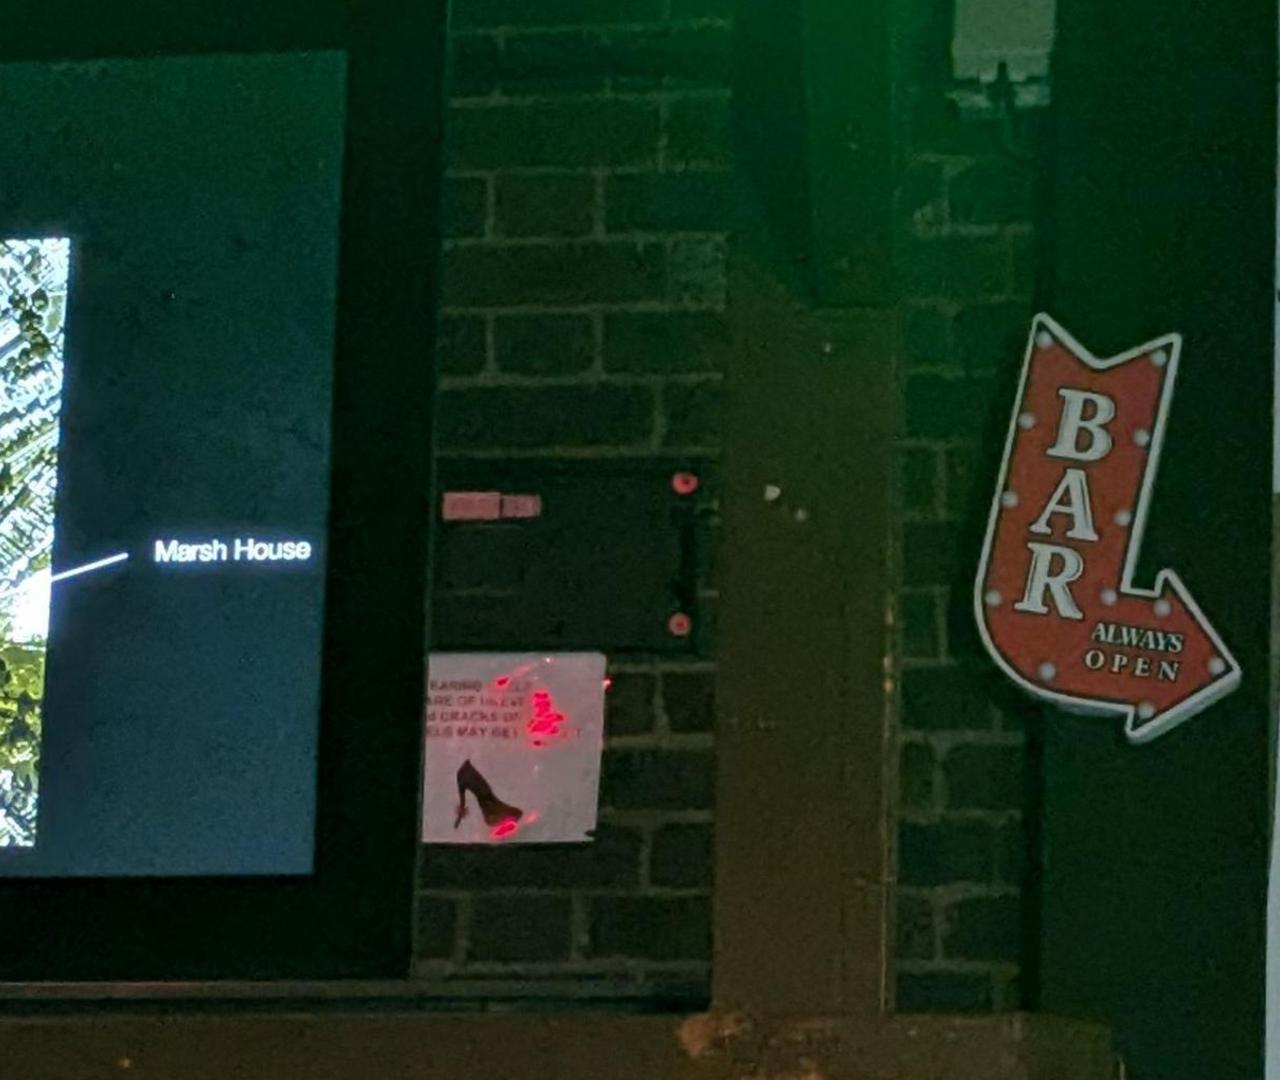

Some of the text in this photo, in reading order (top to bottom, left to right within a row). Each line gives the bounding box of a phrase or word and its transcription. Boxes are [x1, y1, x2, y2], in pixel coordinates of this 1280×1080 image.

[1014, 387, 1116, 620] BAR
[154, 538, 312, 562] Marsh House
[1084, 622, 1185, 682] ALWAYS OPEN
[457, 726, 488, 738] MAY
